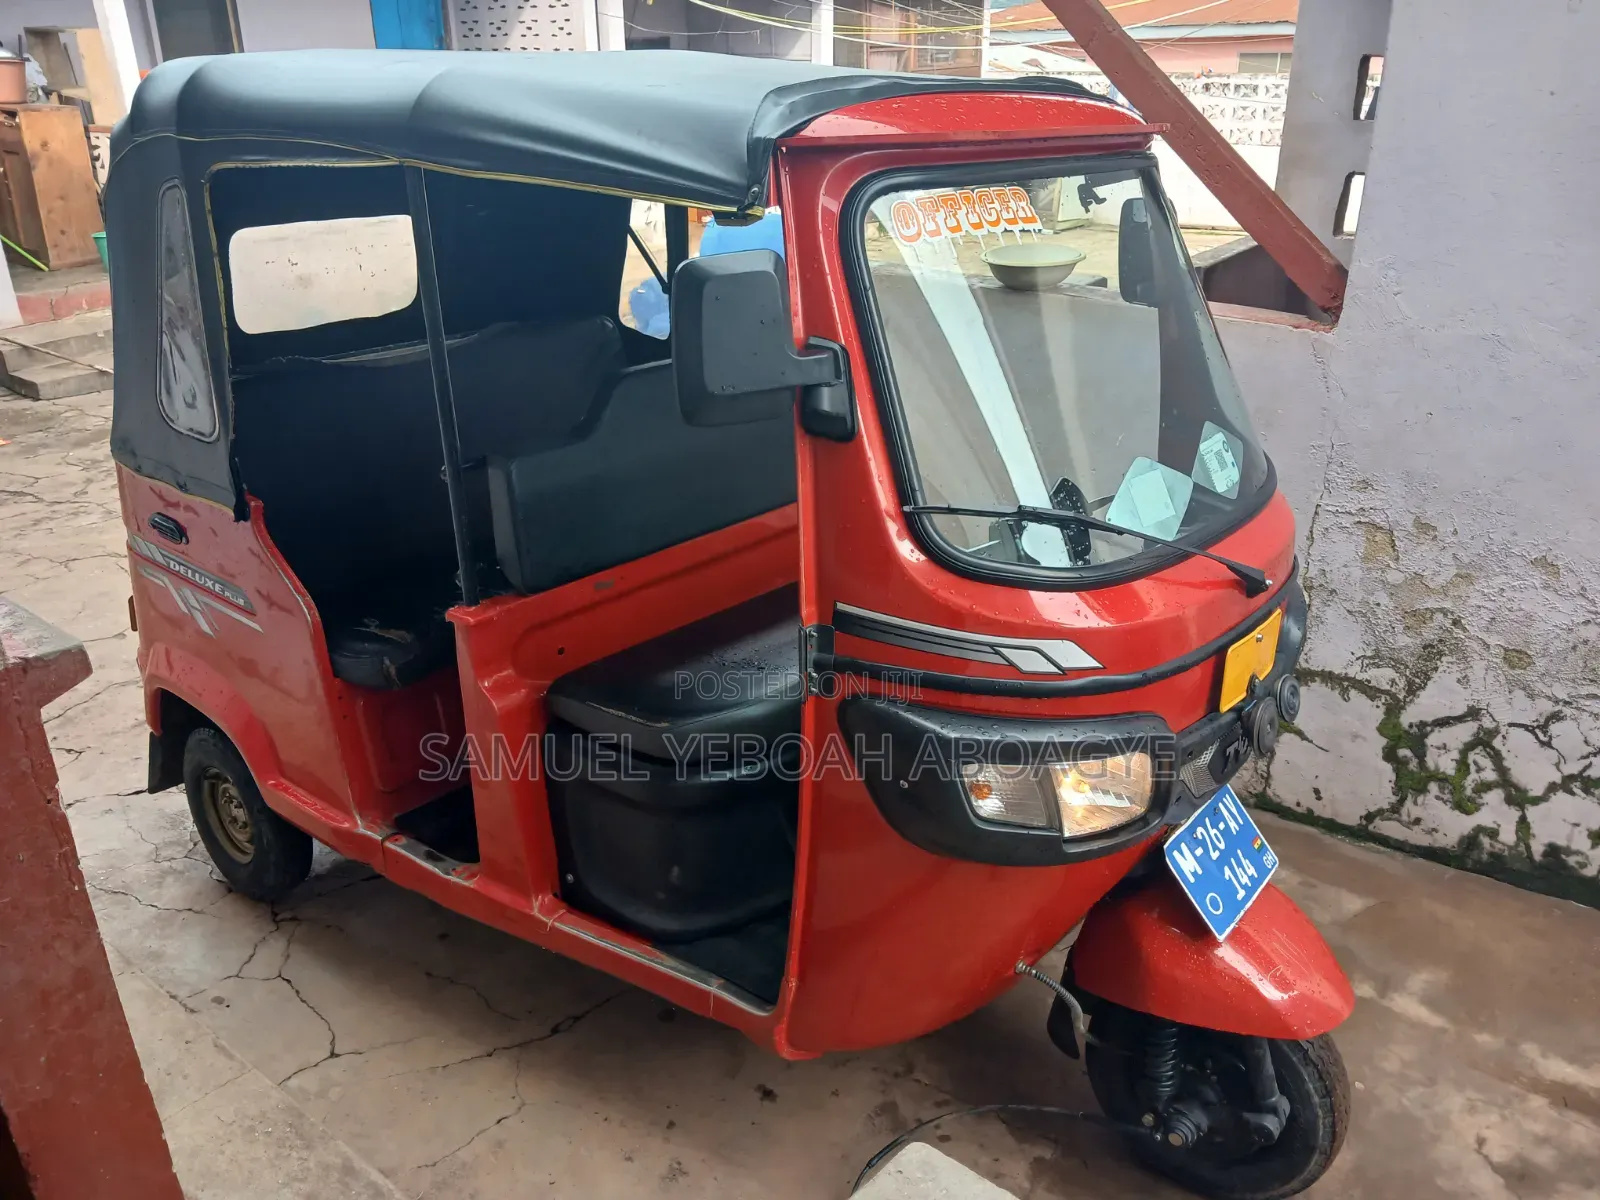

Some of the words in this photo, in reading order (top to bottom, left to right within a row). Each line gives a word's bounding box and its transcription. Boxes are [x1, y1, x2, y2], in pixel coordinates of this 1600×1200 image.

[891, 186, 1040, 243] OFFICER
[169, 560, 224, 595] DELUXE
[1172, 793, 1244, 884] M-26-AY
[1262, 850, 1276, 869] GH
[1223, 849, 1258, 901] 144
